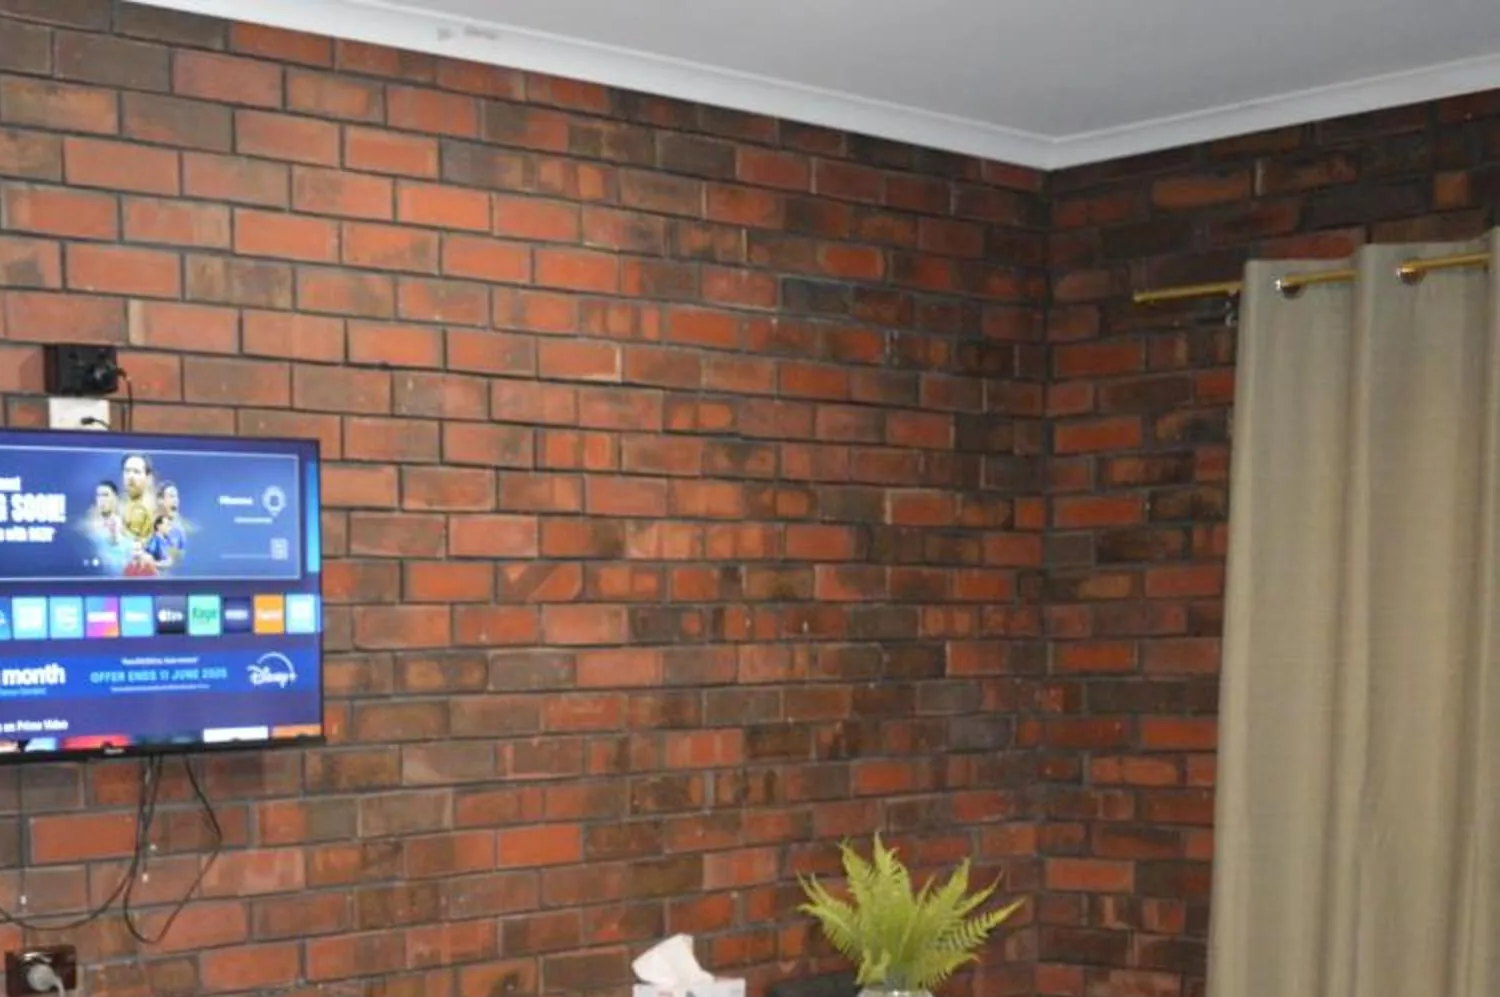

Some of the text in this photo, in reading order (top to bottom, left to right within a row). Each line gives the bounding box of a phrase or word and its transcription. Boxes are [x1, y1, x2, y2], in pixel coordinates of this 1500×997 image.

[1, 662, 67, 686] month
[90, 671, 125, 683] OFFER
[246, 656, 298, 689] Disney+
